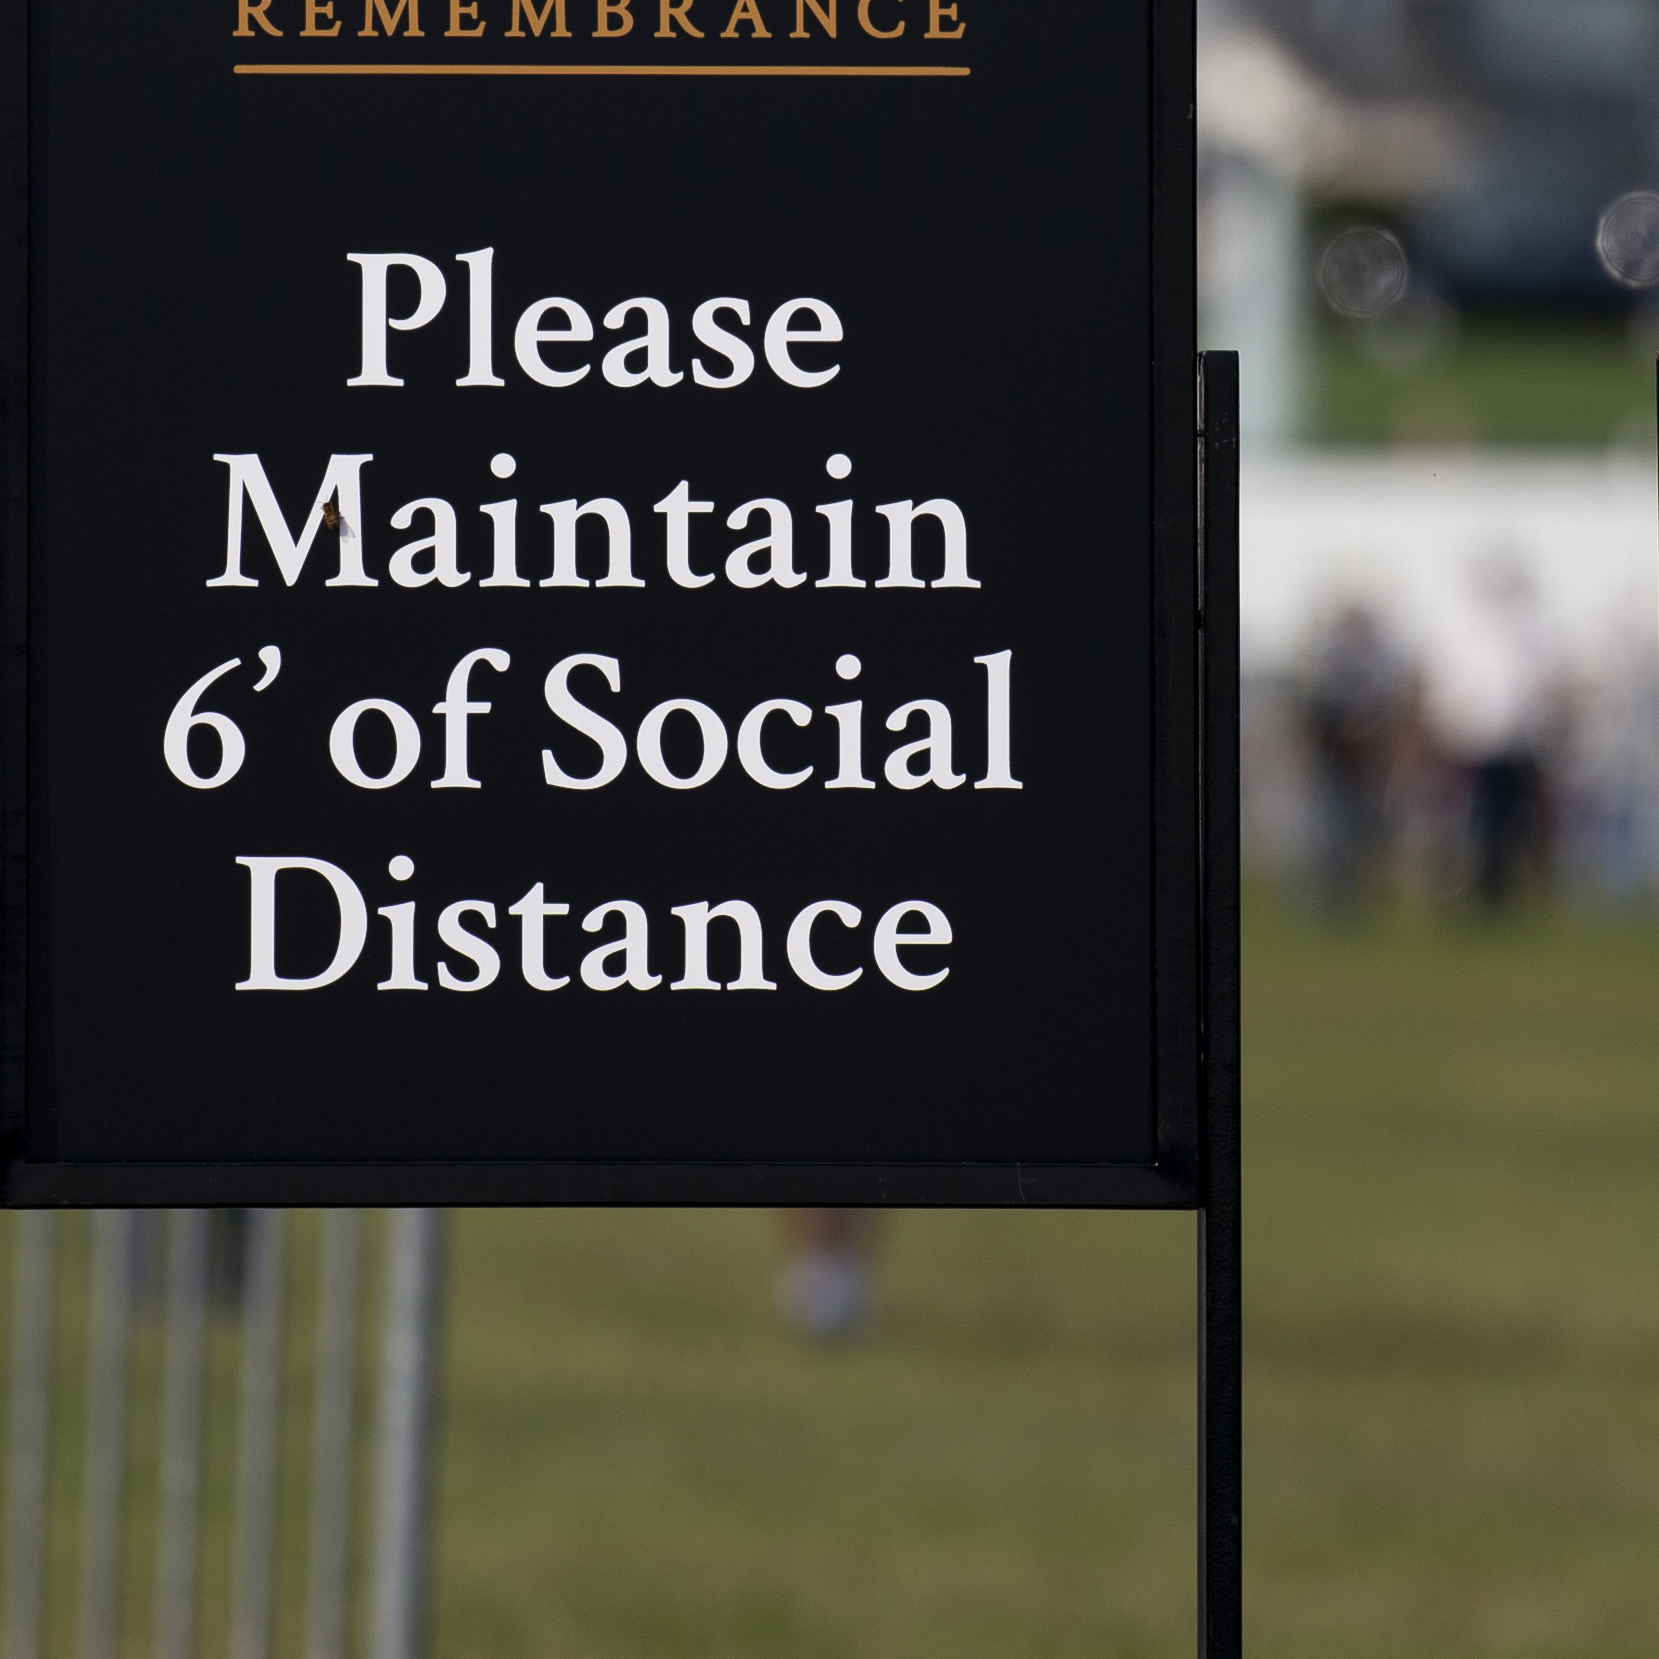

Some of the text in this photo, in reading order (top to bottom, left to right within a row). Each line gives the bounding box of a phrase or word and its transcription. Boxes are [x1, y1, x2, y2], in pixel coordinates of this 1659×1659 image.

[346, 246, 844, 389] Please
[205, 452, 982, 589] Maintain
[328, 647, 511, 790] of
[541, 648, 1024, 791] Social
[234, 854, 953, 992] Distance
